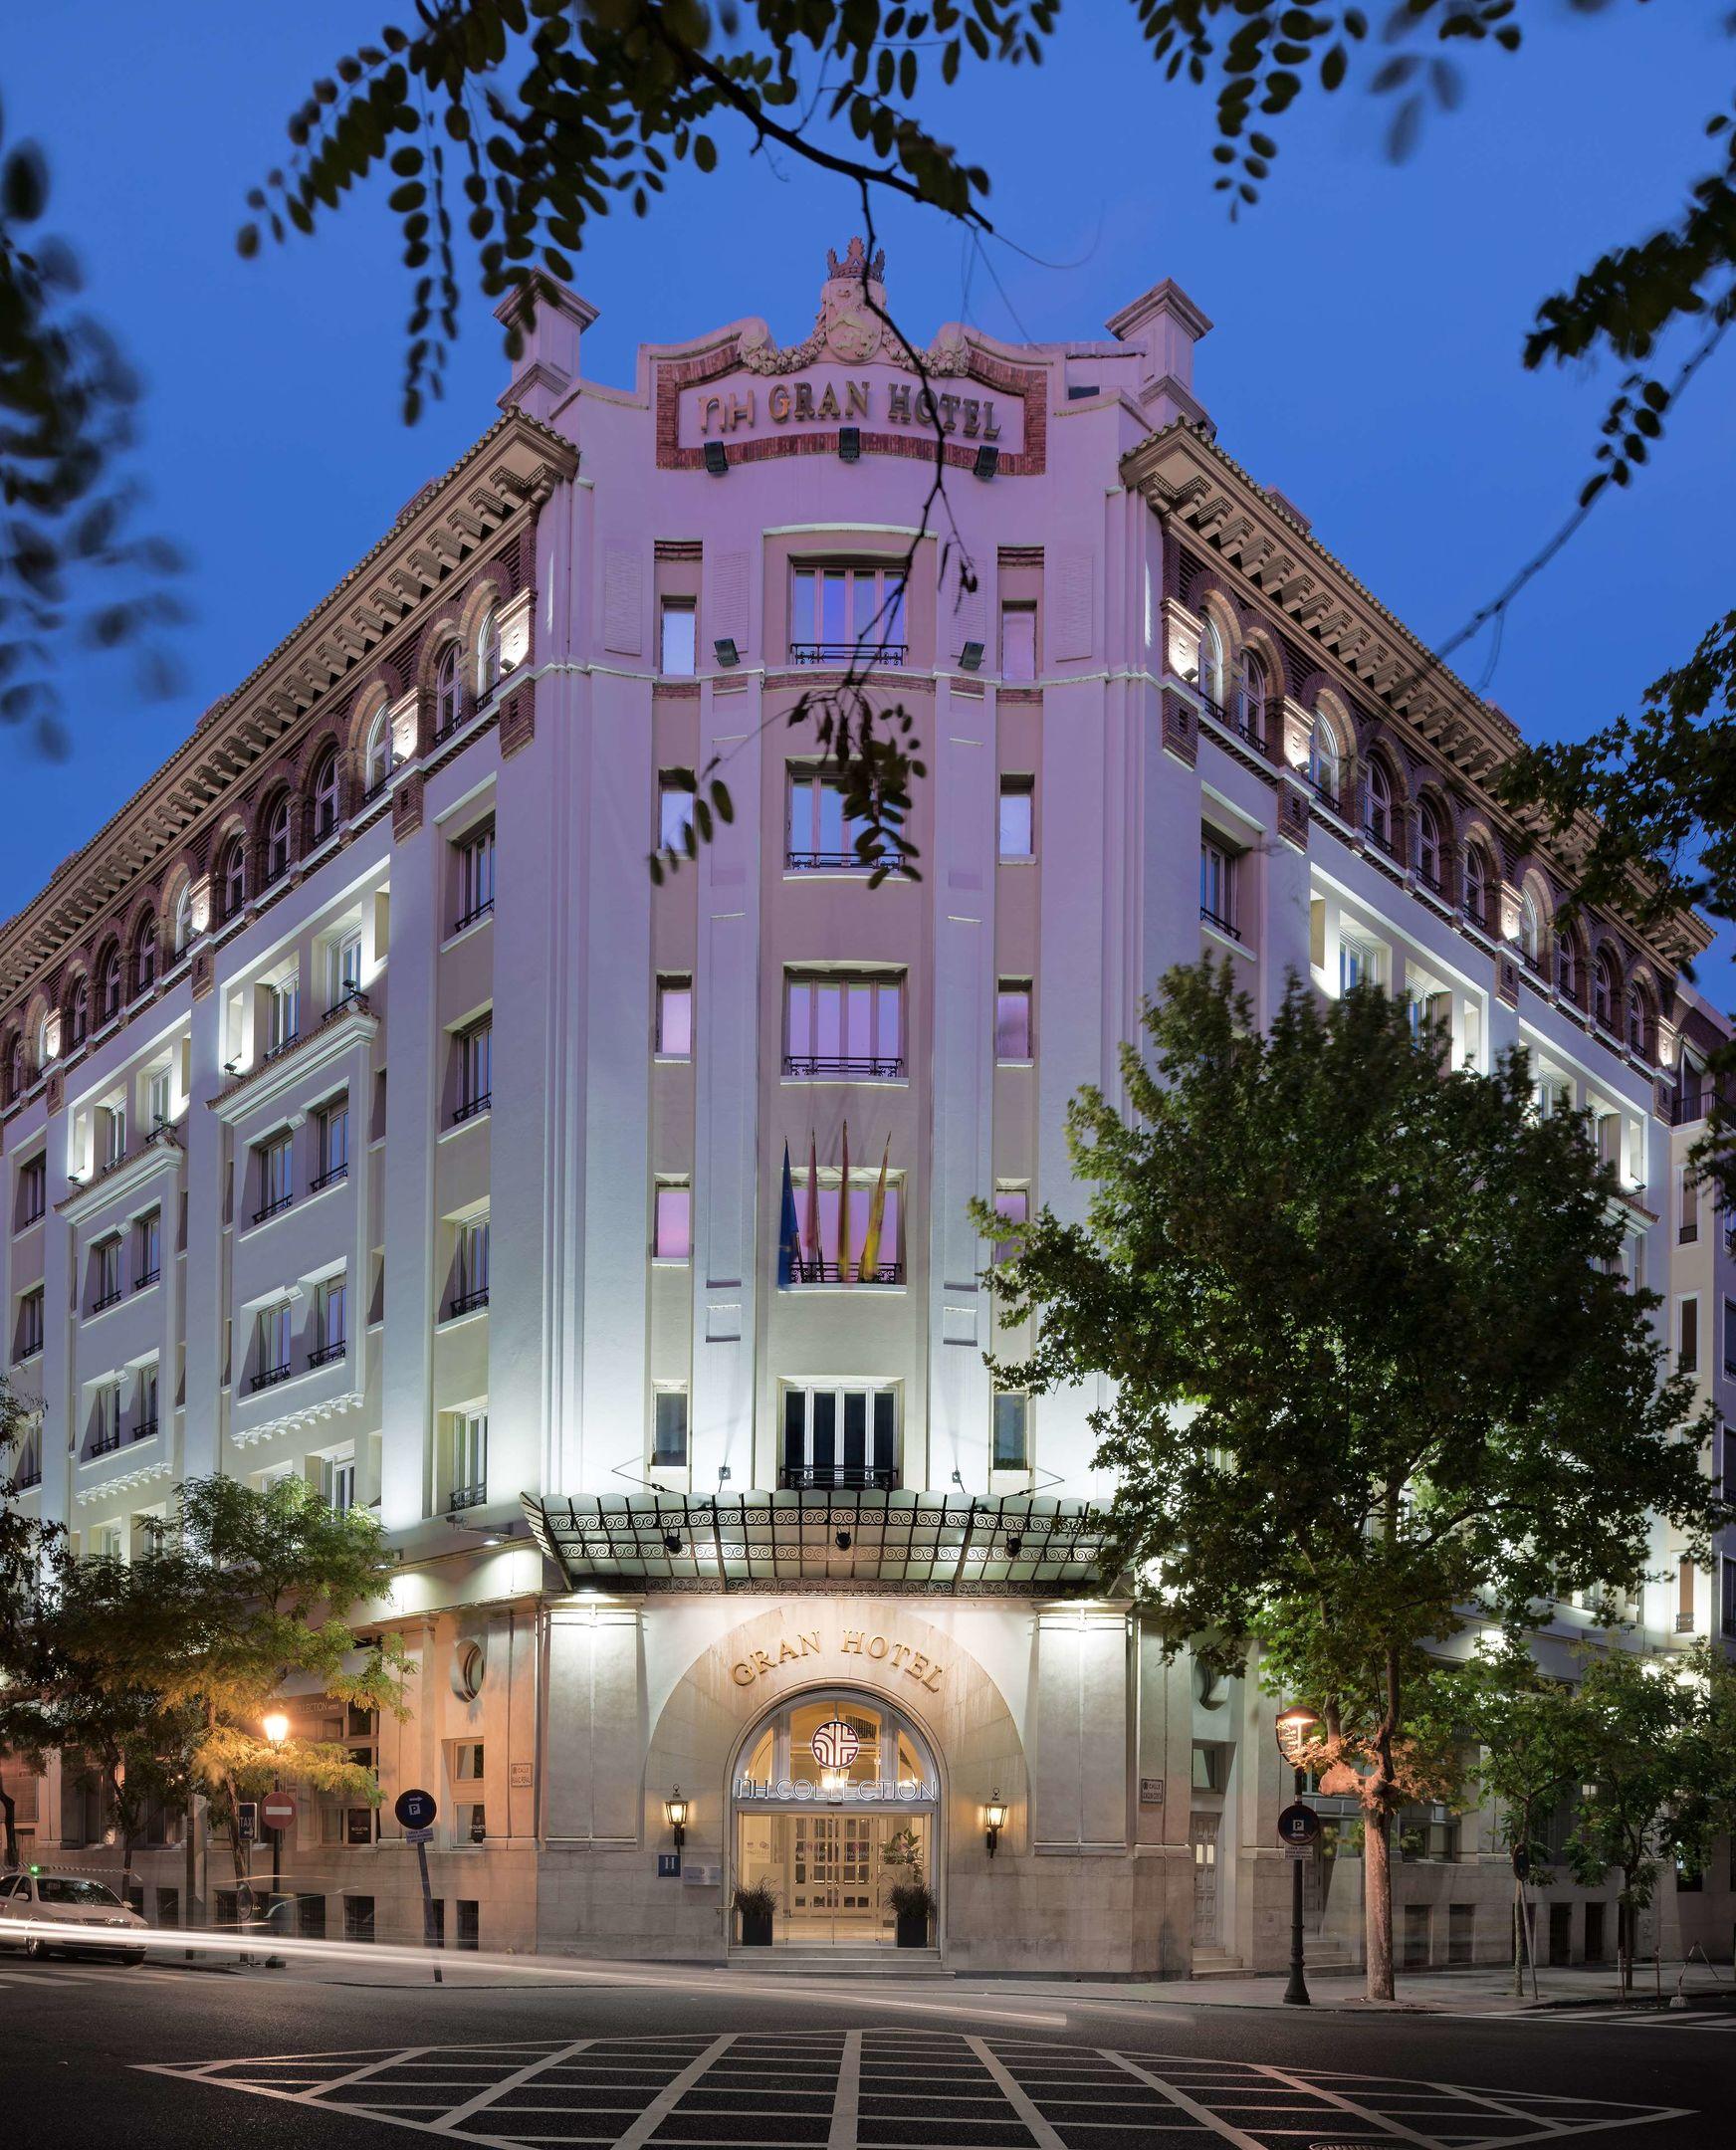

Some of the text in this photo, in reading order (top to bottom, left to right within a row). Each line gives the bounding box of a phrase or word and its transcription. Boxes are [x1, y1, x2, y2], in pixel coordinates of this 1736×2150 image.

[768, 380, 870, 423] GRAN
[888, 381, 1002, 440] HOTEL
[731, 1629, 946, 1694] GRAN HOTEL
[775, 1778, 938, 1801] COLLECTION
[239, 1817, 256, 1828] TAXI
